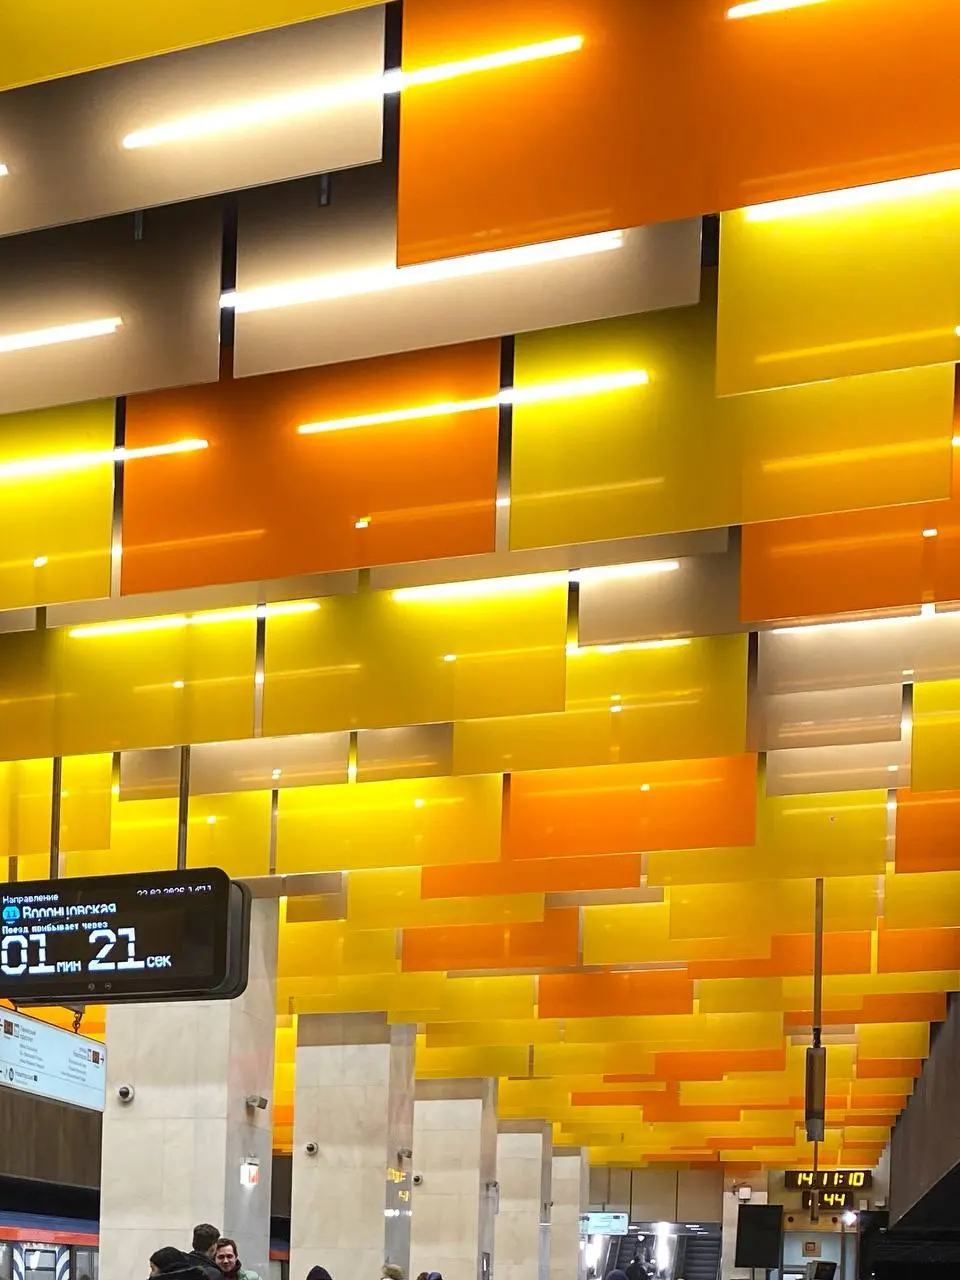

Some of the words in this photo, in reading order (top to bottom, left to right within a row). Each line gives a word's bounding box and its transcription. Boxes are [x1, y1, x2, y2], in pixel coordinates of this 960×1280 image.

[3, 894, 59, 904] Направление
[2, 925, 29, 935] Поезд
[31, 923, 79, 933] прибывает
[82, 921, 109, 930] через
[1, 933, 55, 975] 01
[57, 960, 81, 973] мин
[88, 927, 145, 971] 21
[146, 955, 172, 968] сек
